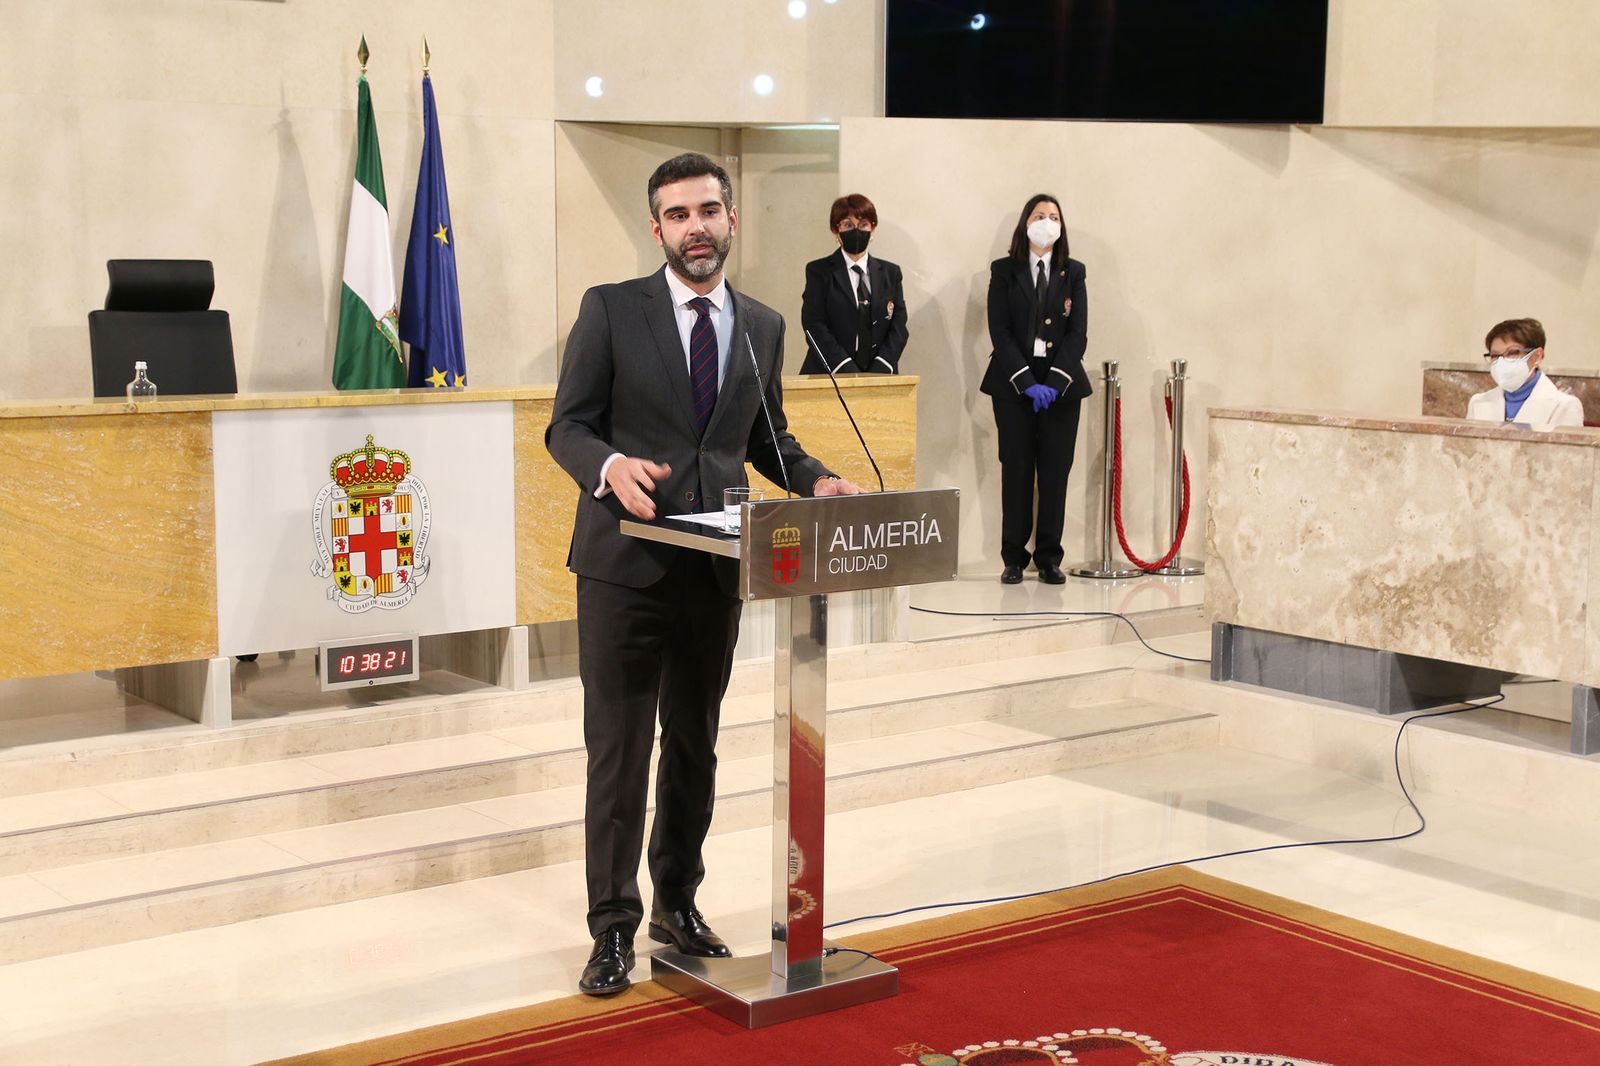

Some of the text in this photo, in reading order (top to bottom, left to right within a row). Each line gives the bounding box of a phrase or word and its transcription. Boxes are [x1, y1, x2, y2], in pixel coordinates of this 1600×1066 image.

[415, 525, 429, 559] LIBERTAD
[829, 513, 943, 553] ALMERÍA
[828, 554, 888, 575] CIUDAD
[345, 601, 370, 611] CIUDAD
[340, 650, 406, 673] 10 38 21
